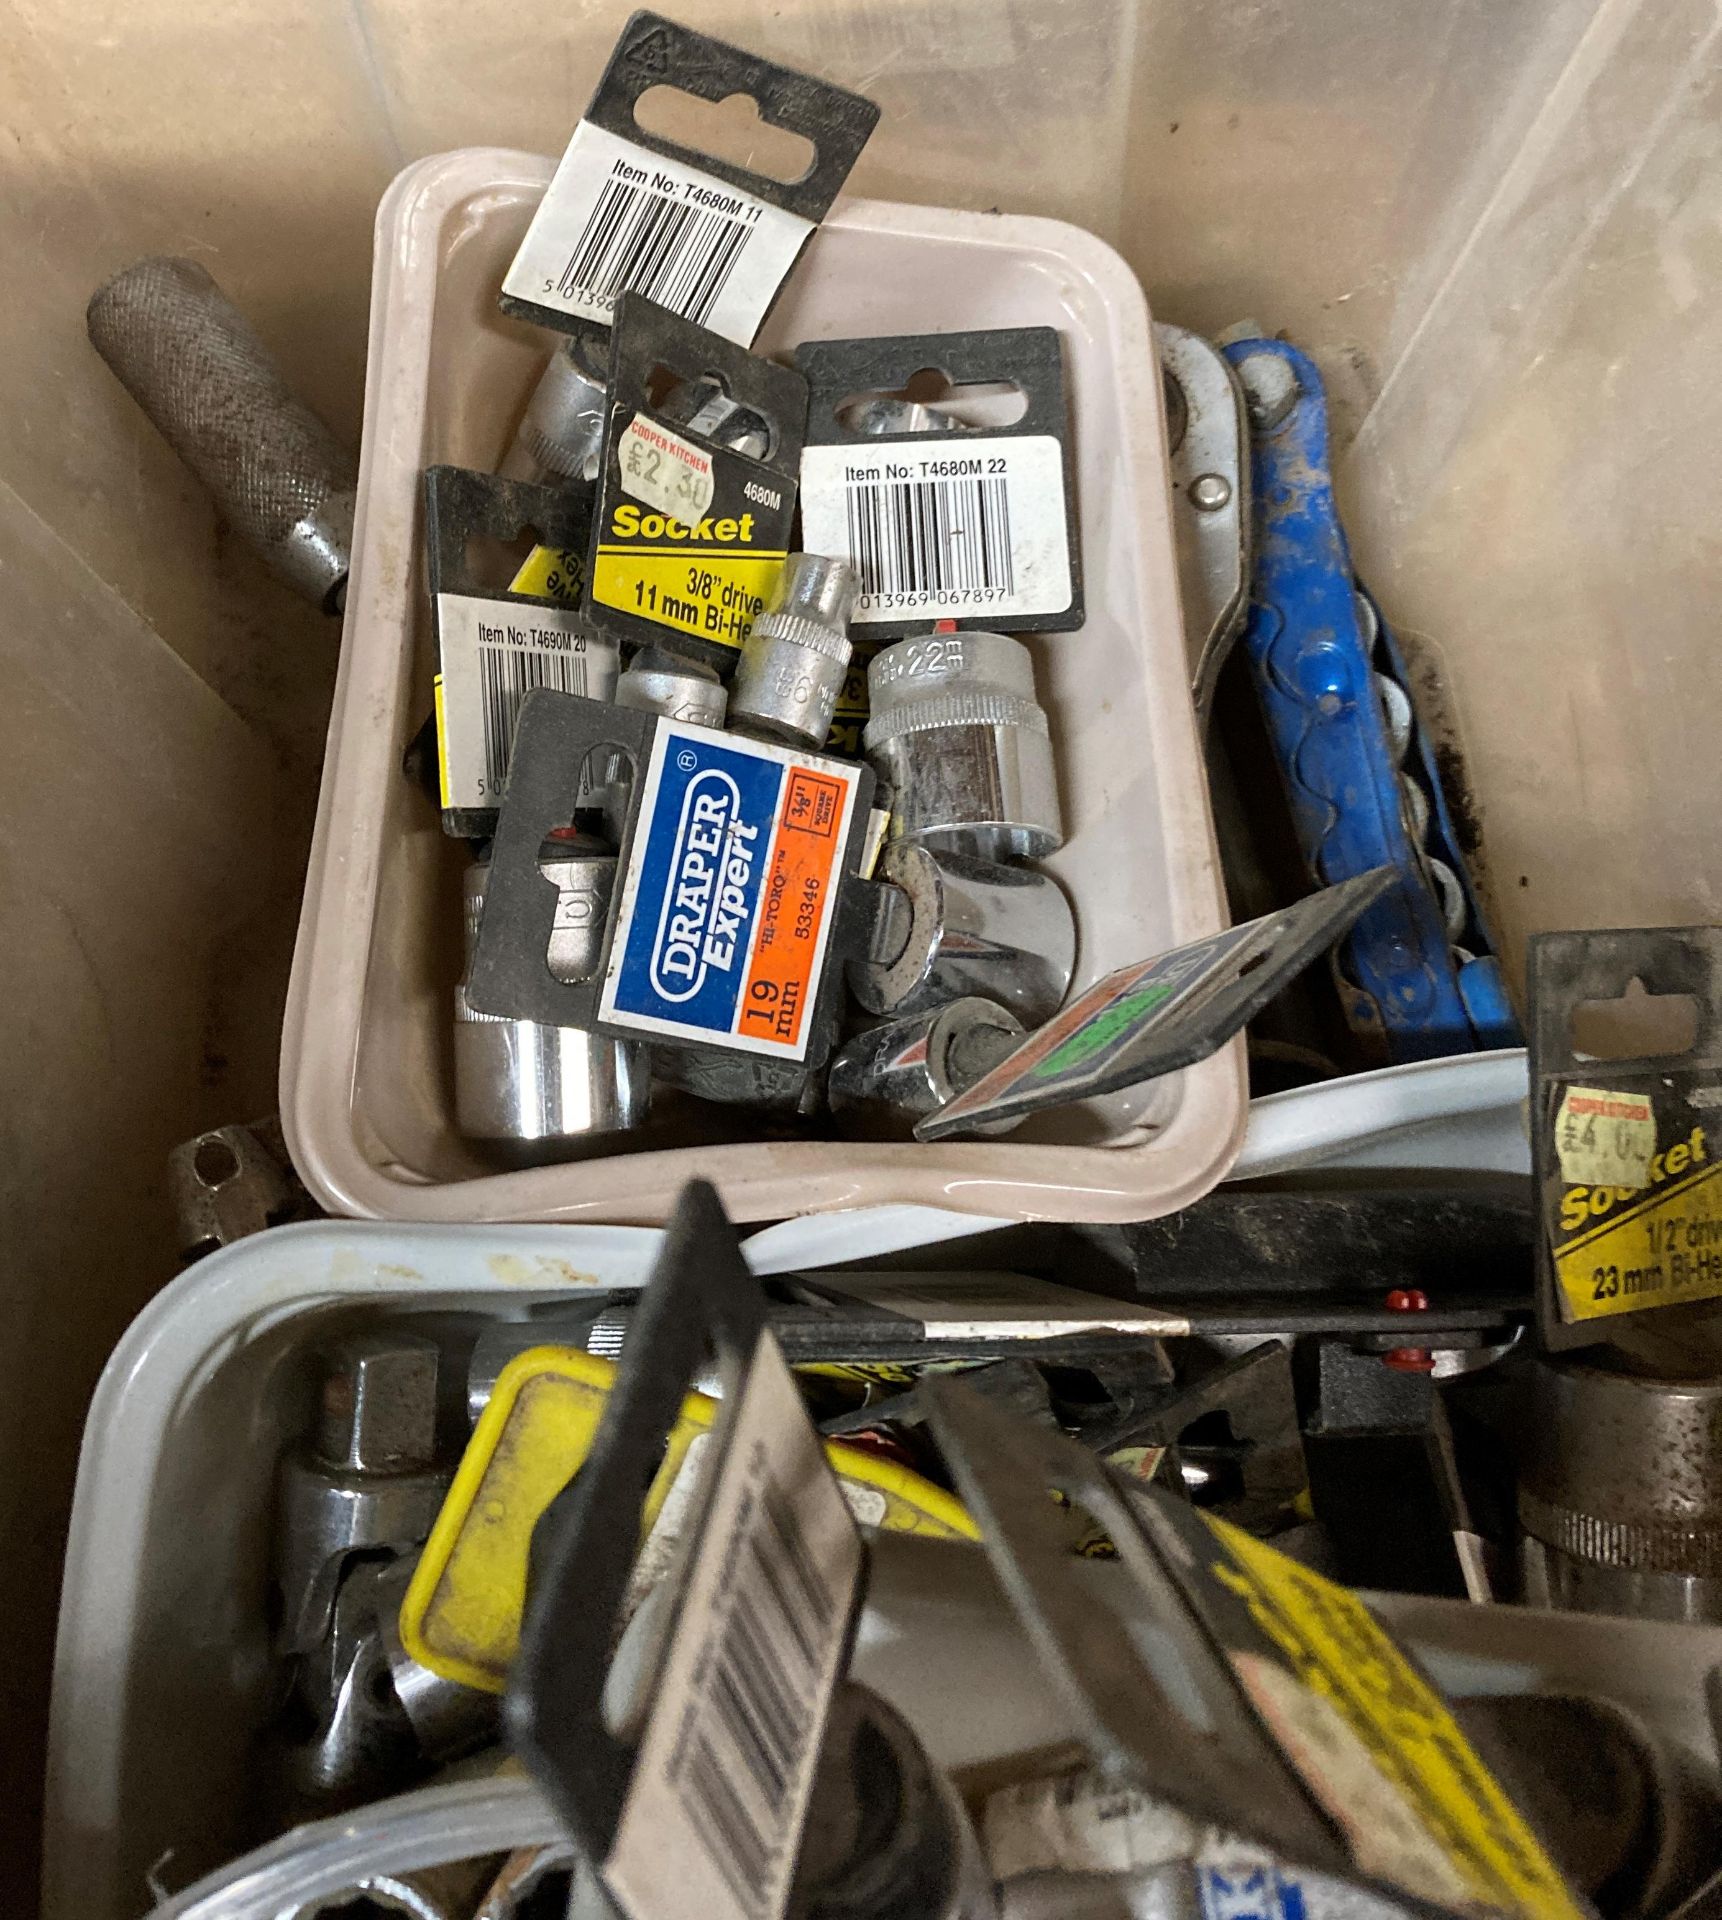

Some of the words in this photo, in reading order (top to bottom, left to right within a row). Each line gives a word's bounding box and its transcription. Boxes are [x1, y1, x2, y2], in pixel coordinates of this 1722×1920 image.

[612, 158, 648, 184] Item
[651, 172, 680, 195] No:
[684, 183, 743, 216] T4680M
[746, 206, 763, 223] 11
[542, 279, 554, 293] 5
[631, 421, 668, 449] COOPER
[669, 442, 708, 474] KITCHEN
[845, 466, 880, 482] Item
[886, 464, 914, 479] No:
[919, 460, 982, 477] T4680M
[988, 459, 1007, 474] 22
[743, 480, 781, 512] 4680M
[611, 505, 755, 542] Socket
[636, 580, 657, 611] 11
[662, 595, 699, 625] mm
[705, 604, 752, 641] Bi-He
[722, 582, 763, 616] drive
[937, 588, 1006, 606] 067897
[479, 622, 504, 644] Item
[508, 625, 527, 646] No:
[530, 628, 571, 651] T4690M
[574, 635, 587, 653] 20
[662, 794, 729, 980] DRAPER
[702, 819, 758, 972] Expert
[795, 877, 820, 940] 53346
[747, 979, 779, 1024] 19
[776, 980, 800, 1037] mm
[1592, 1265, 1618, 1299] 23
[1671, 1248, 1722, 1287] Bi-He
